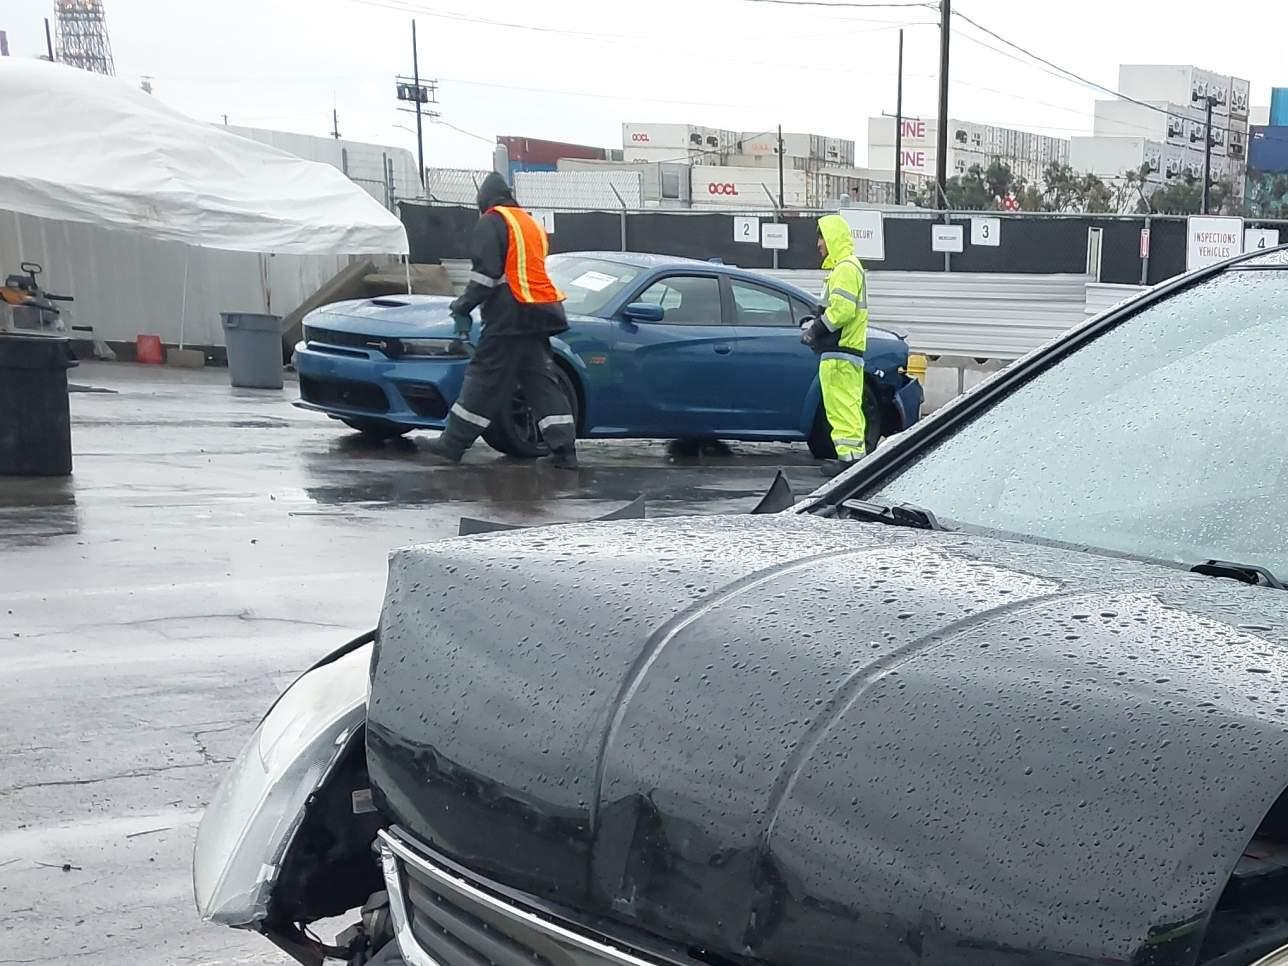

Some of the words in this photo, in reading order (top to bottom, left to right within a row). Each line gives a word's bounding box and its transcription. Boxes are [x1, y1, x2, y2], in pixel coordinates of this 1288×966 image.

[708, 182, 739, 196] OOCL
[743, 223, 750, 236] 2
[982, 225, 990, 239] 3
[1194, 231, 1237, 244] INSPECTIONS
[1257, 237, 1266, 249] 4
[1199, 247, 1230, 258] VEHICLES
